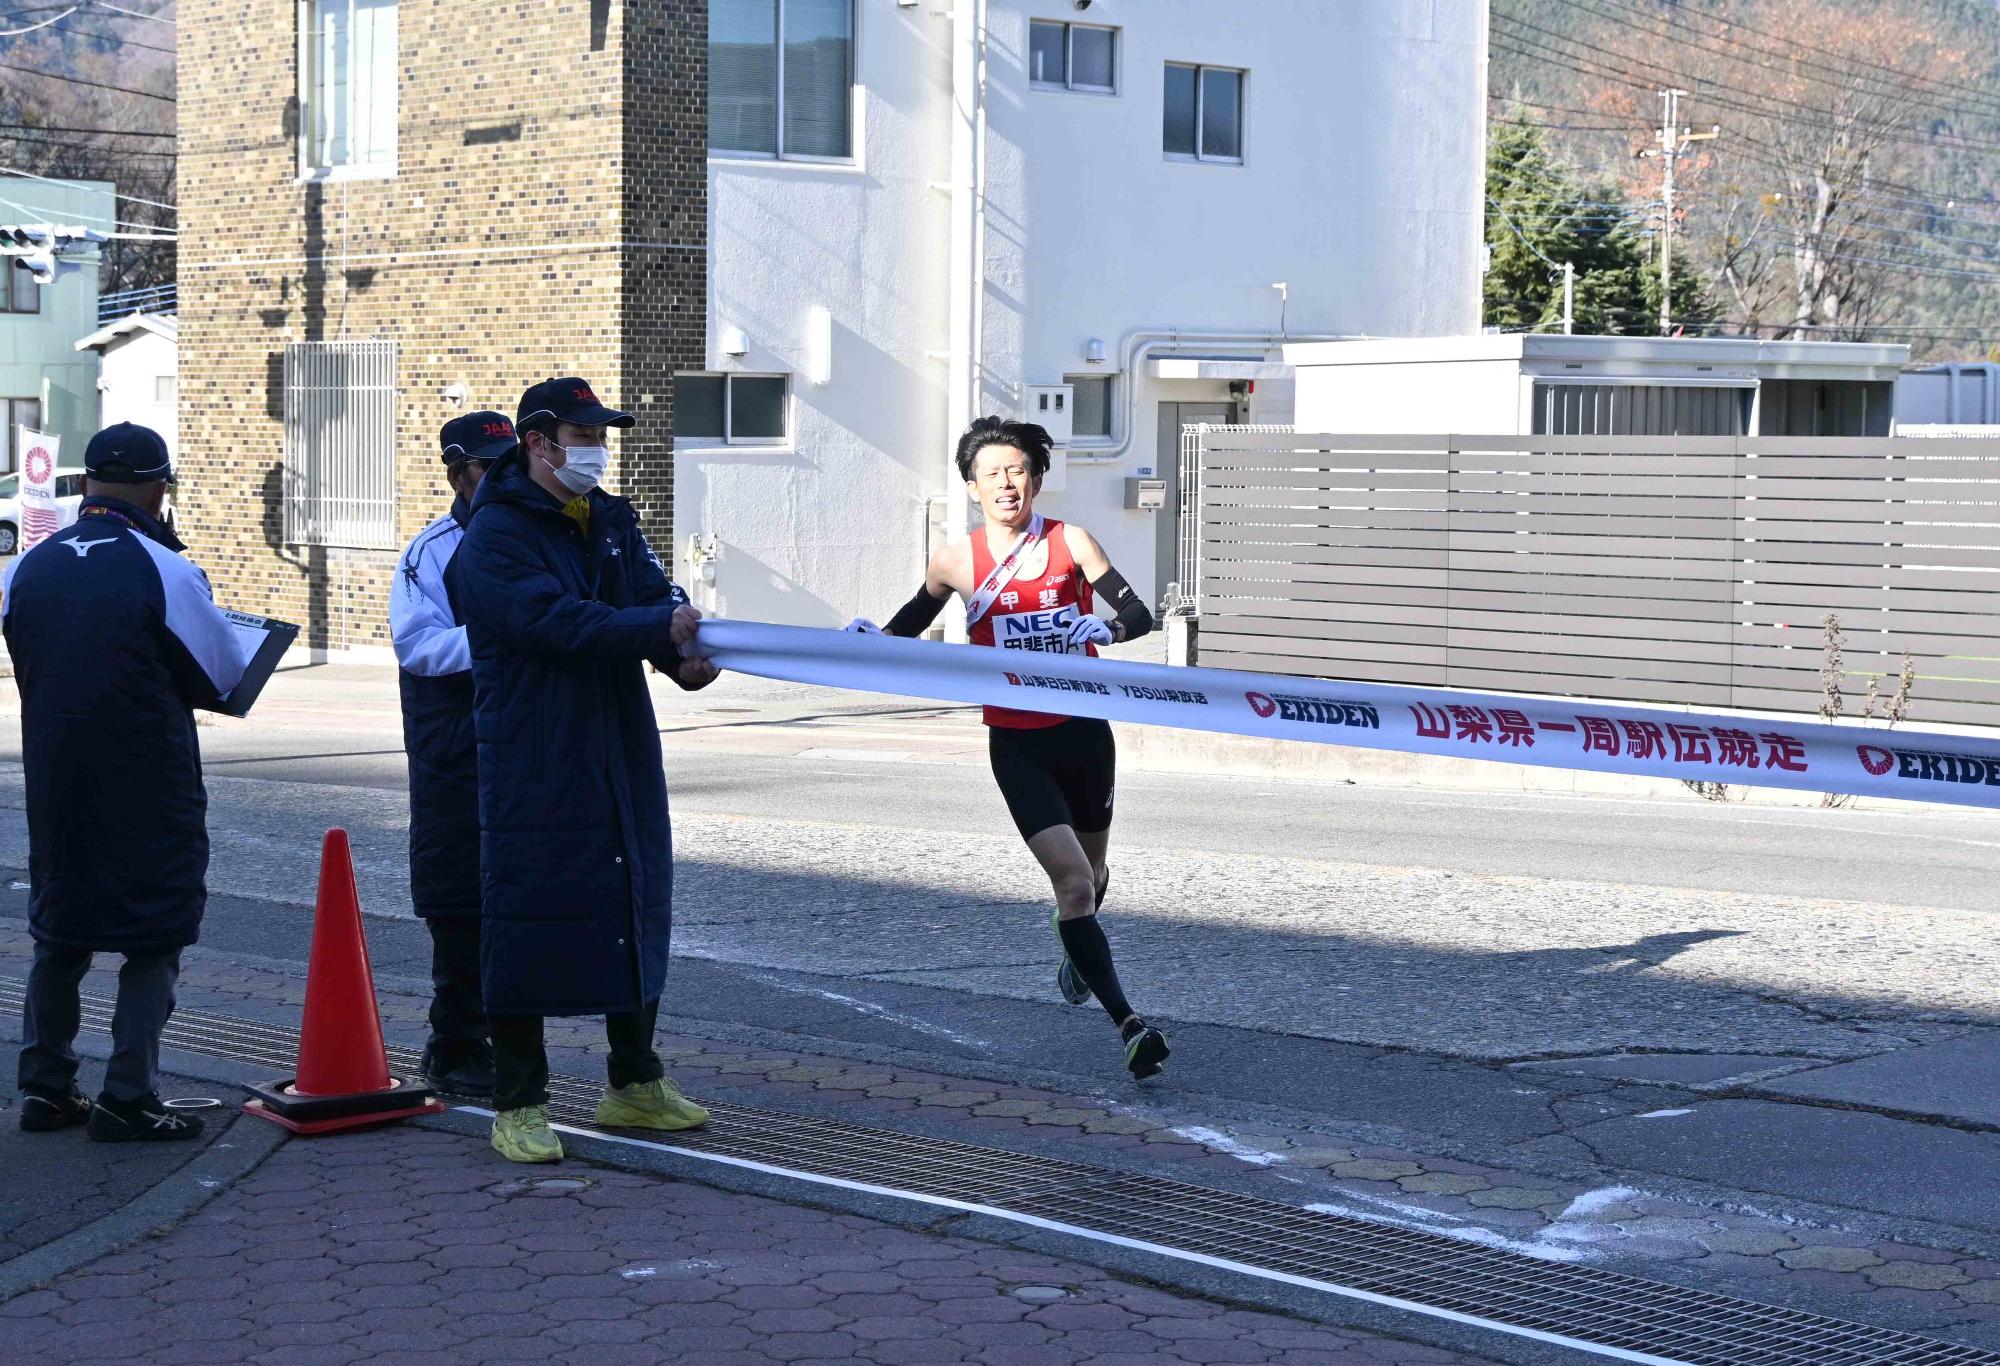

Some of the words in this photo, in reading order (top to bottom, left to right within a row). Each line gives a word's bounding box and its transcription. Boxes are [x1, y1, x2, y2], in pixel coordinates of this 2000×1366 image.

[1006, 608, 1071, 635] NEC
[1020, 673, 1110, 696] 山梨日日新聞社
[1117, 684, 1209, 705] YBS山梨放送
[1275, 699, 1380, 729] EKIDEN
[1408, 701, 1808, 772] 山梨県一周駅伝競走
